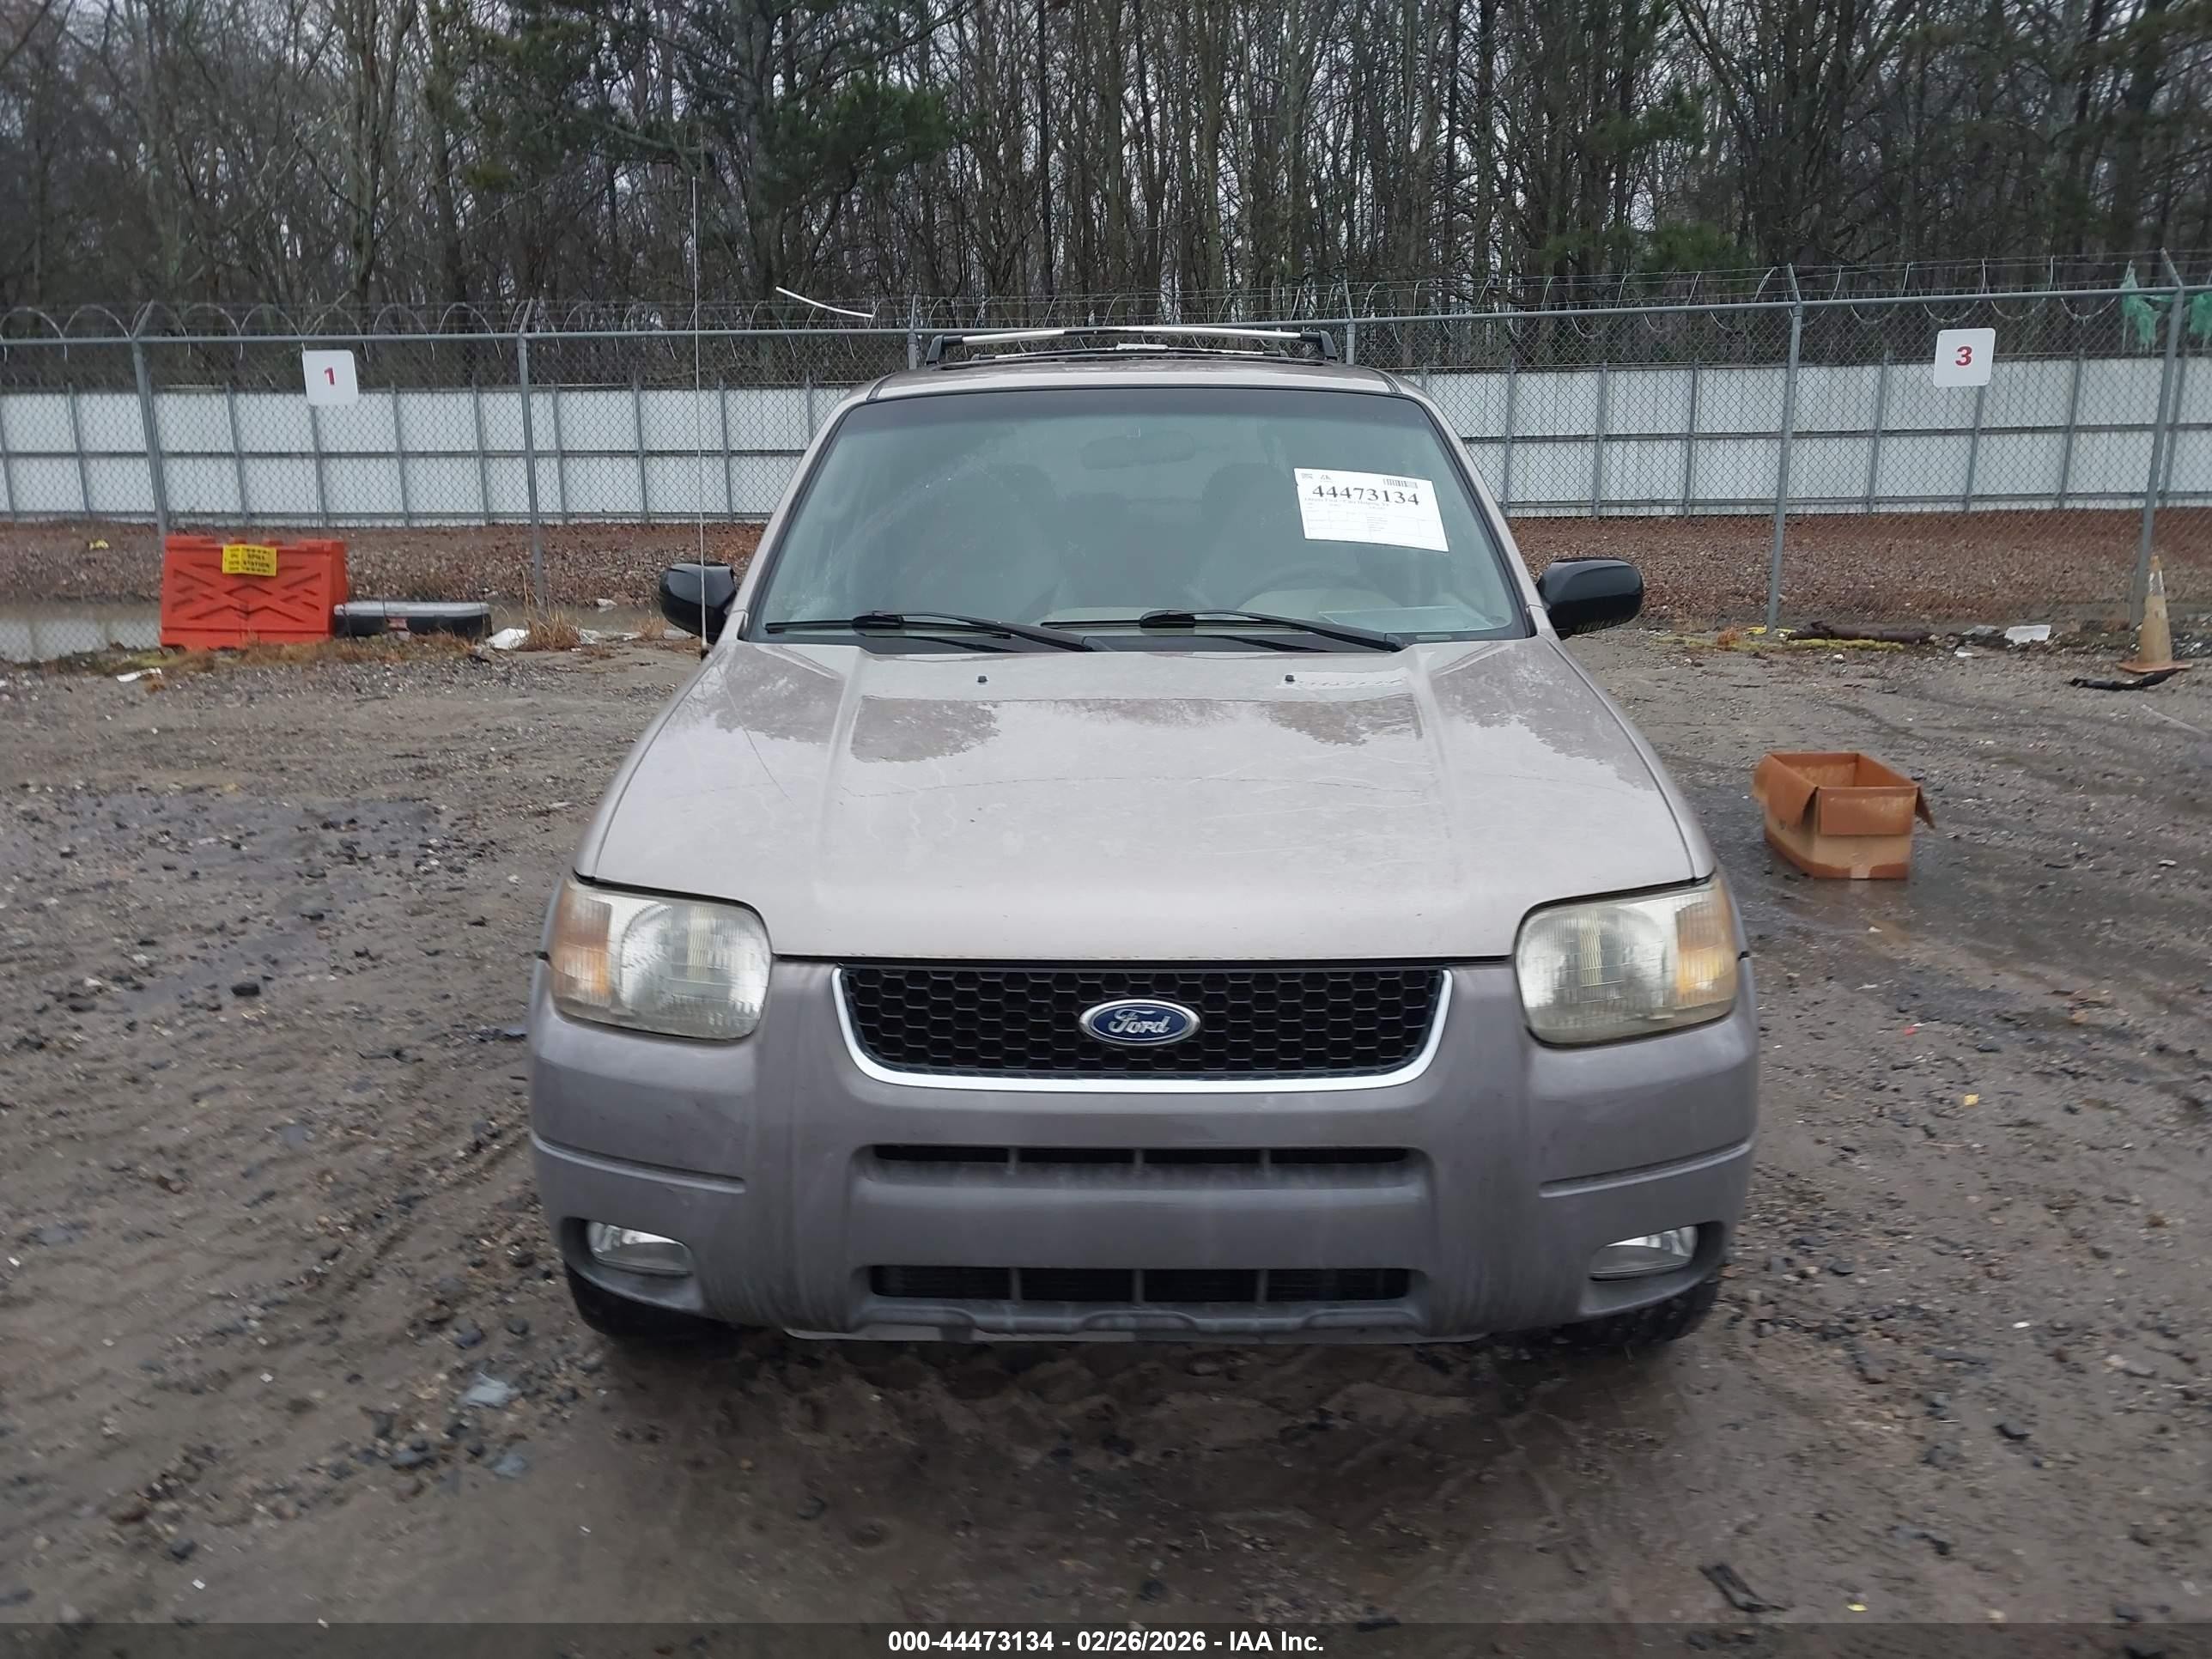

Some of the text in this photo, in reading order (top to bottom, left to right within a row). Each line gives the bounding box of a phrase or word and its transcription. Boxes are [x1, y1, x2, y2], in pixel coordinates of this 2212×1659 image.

[1955, 346, 1972, 366] 3
[324, 368, 335, 385] 1
[1312, 484, 1419, 506] 44473134
[242, 560, 270, 568] STATION
[1108, 1008, 1171, 1034] Ford
